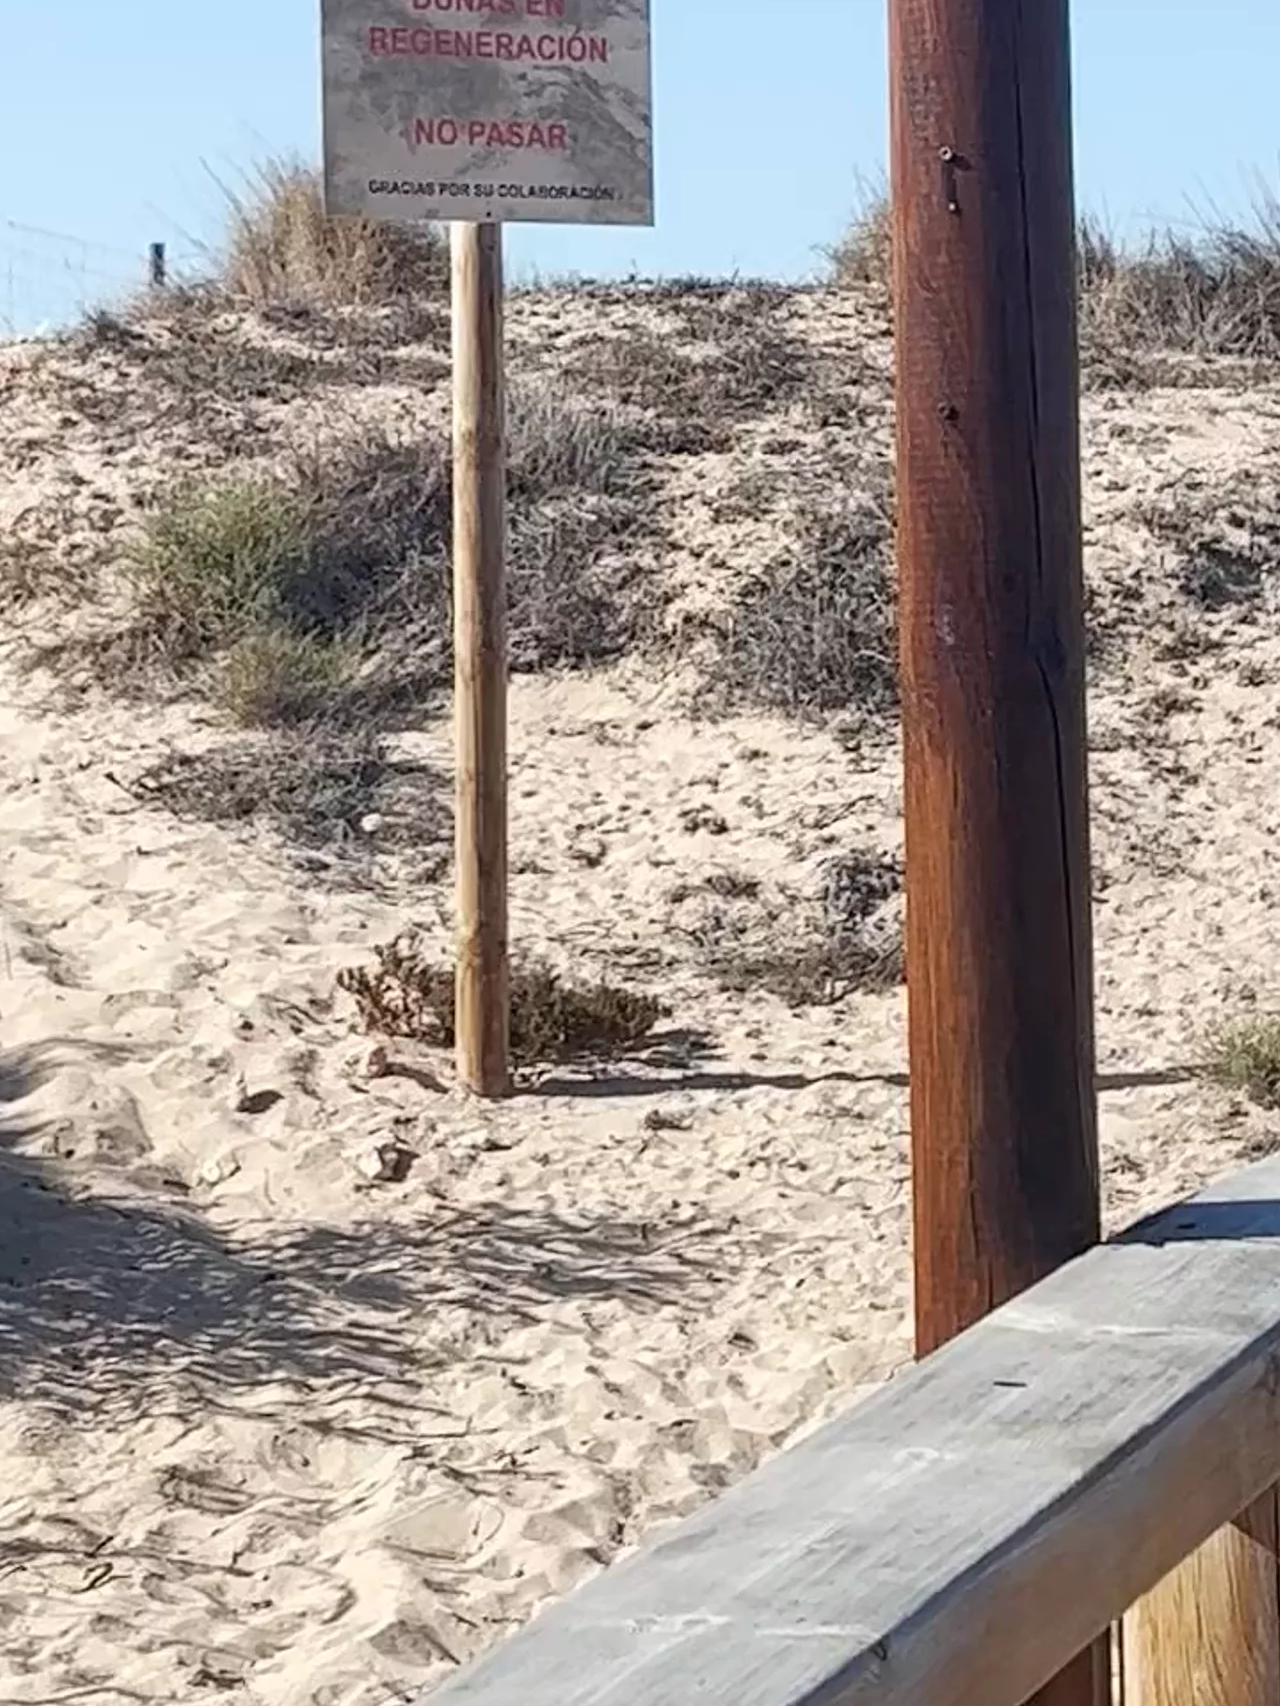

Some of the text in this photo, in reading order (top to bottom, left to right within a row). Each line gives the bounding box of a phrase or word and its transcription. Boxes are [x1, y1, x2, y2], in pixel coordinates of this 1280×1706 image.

[369, 25, 608, 63] REGENERACIÓN
[415, 119, 568, 151] NO PASAR
[368, 179, 615, 201] GRACIAS POR SU COLABORACIÓN
